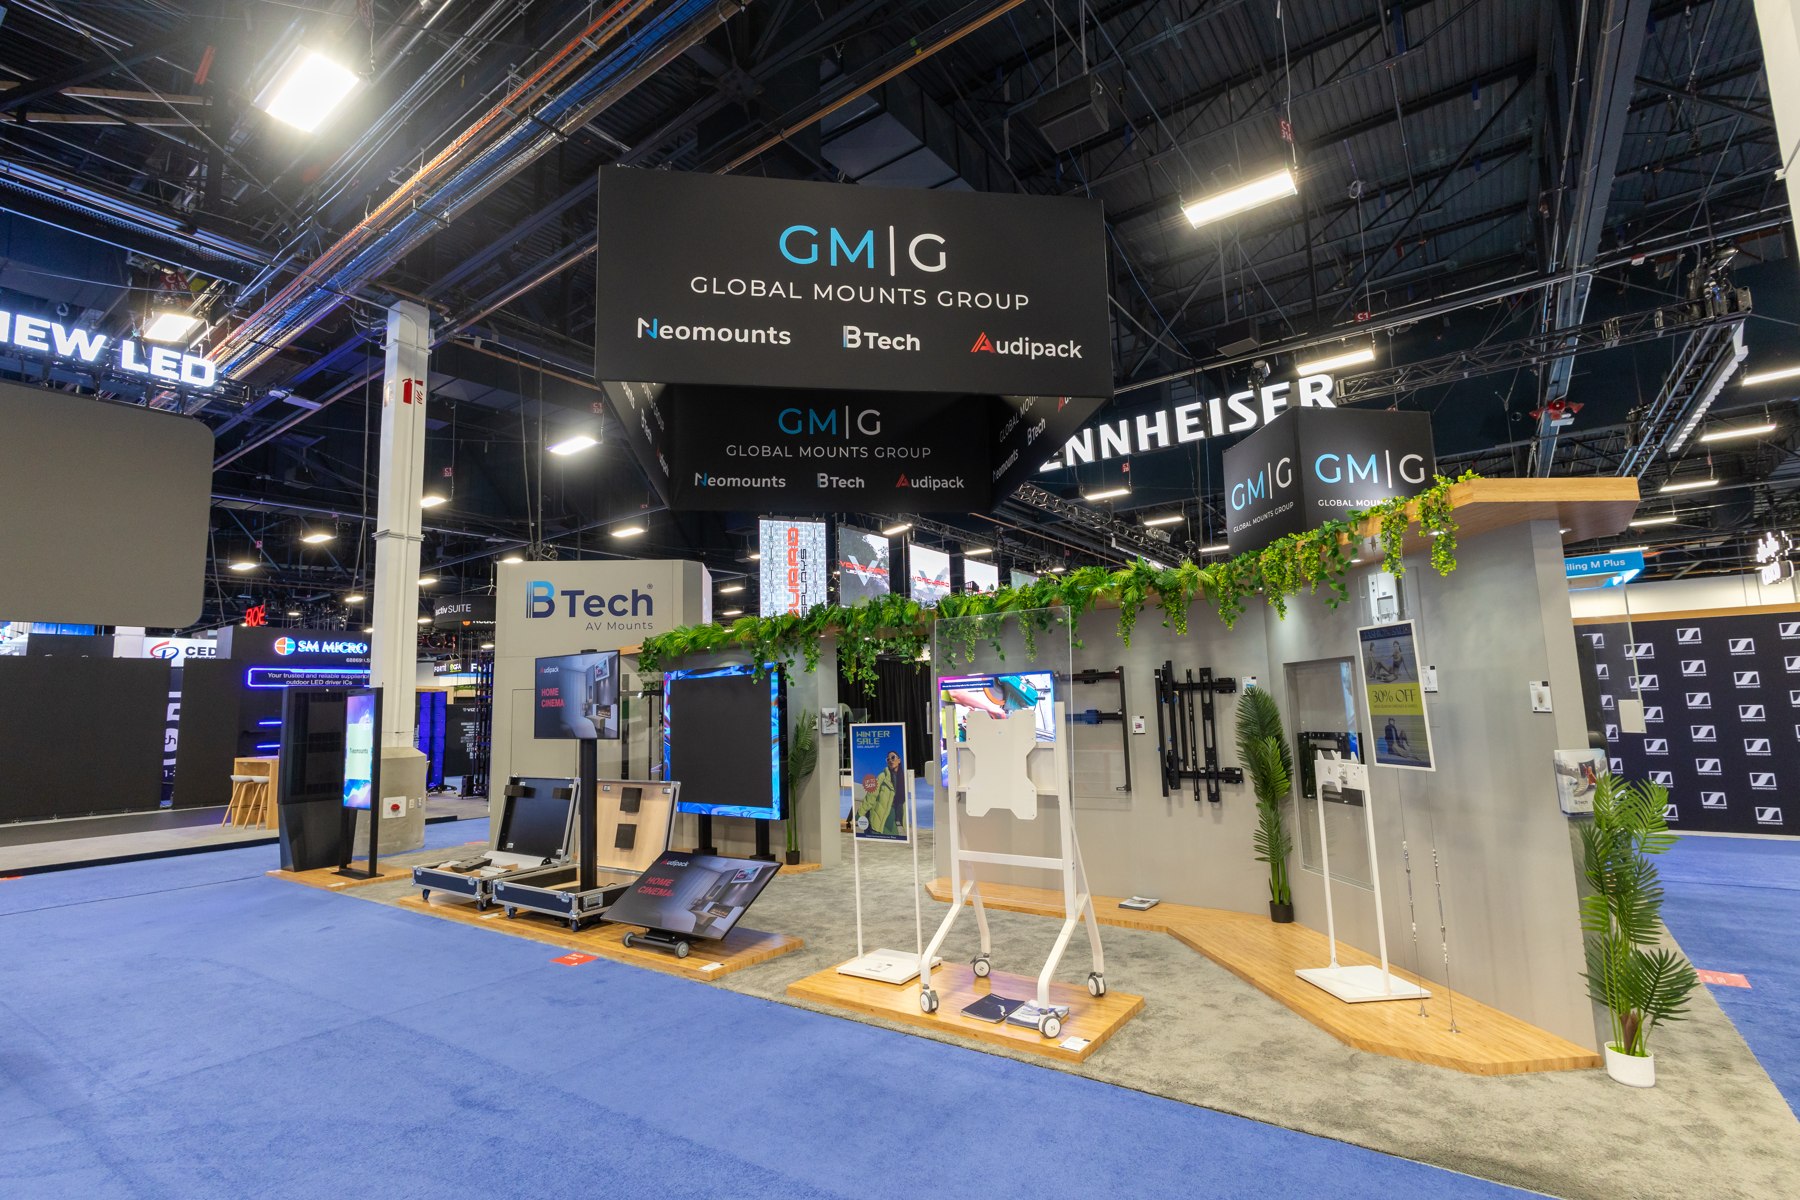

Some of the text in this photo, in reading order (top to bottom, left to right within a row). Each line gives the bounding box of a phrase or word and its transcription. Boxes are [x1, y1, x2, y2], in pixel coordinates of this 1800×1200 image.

[690, 276, 1029, 311] GLOBAL MOUNTS GROUP
[637, 317, 792, 346] Neomounts
[970, 331, 1083, 360] Audipack
[121, 339, 217, 387] LED
[726, 445, 931, 459] GLOBAL MOUNTS GROUP
[694, 472, 787, 488] Neomounts
[895, 473, 965, 492] Audipack
[1318, 499, 1353, 507] GLOBAL
[1233, 501, 1294, 533] GLOBAL MOUNTS GROUP
[1590, 560, 1601, 568] M
[1603, 558, 1626, 567] Plus
[245, 604, 265, 627] ROE
[585, 621, 654, 631] AV Mounts
[298, 640, 368, 654] SM MICRO
[541, 666, 559, 674] Audipack
[541, 688, 559, 697] HOME
[1372, 688, 1416, 703] 30% OFF
[541, 699, 565, 708] CINEMA
[856, 730, 890, 738] WINTER
[857, 737, 880, 745] SALE
[646, 877, 674, 887] HOME
[638, 886, 675, 897] CINEMA
